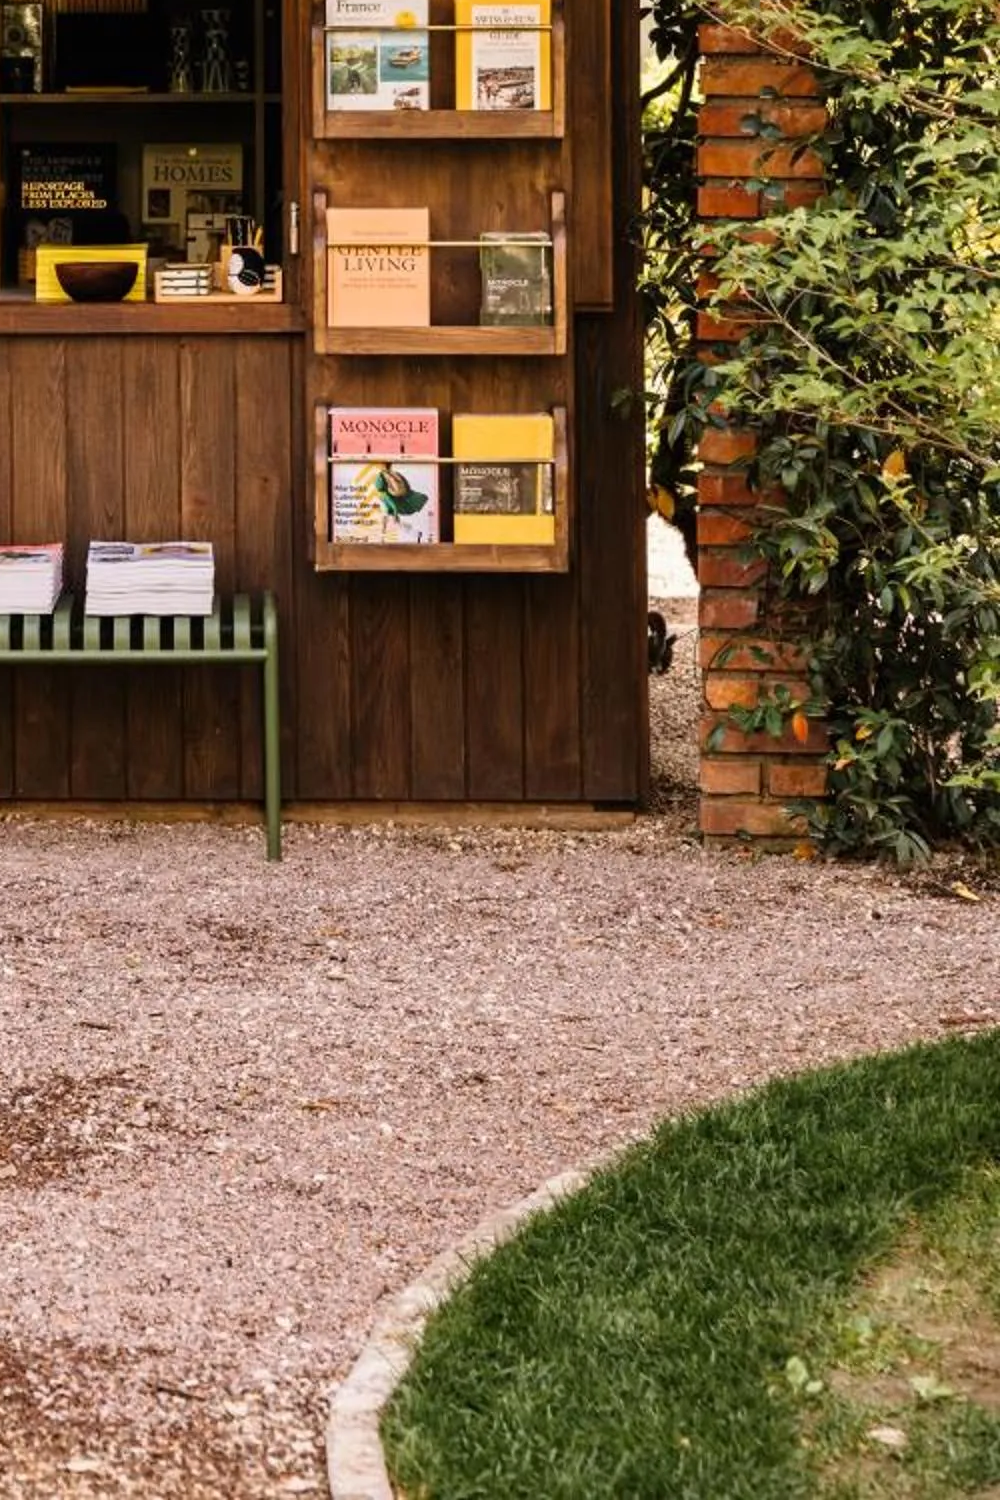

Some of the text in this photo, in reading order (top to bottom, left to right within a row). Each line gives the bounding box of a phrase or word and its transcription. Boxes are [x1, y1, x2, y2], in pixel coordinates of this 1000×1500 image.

[336, 0, 381, 14] France
[153, 165, 233, 182] HOMES
[344, 257, 416, 271] LIVING
[340, 419, 429, 433] MONOCLE
